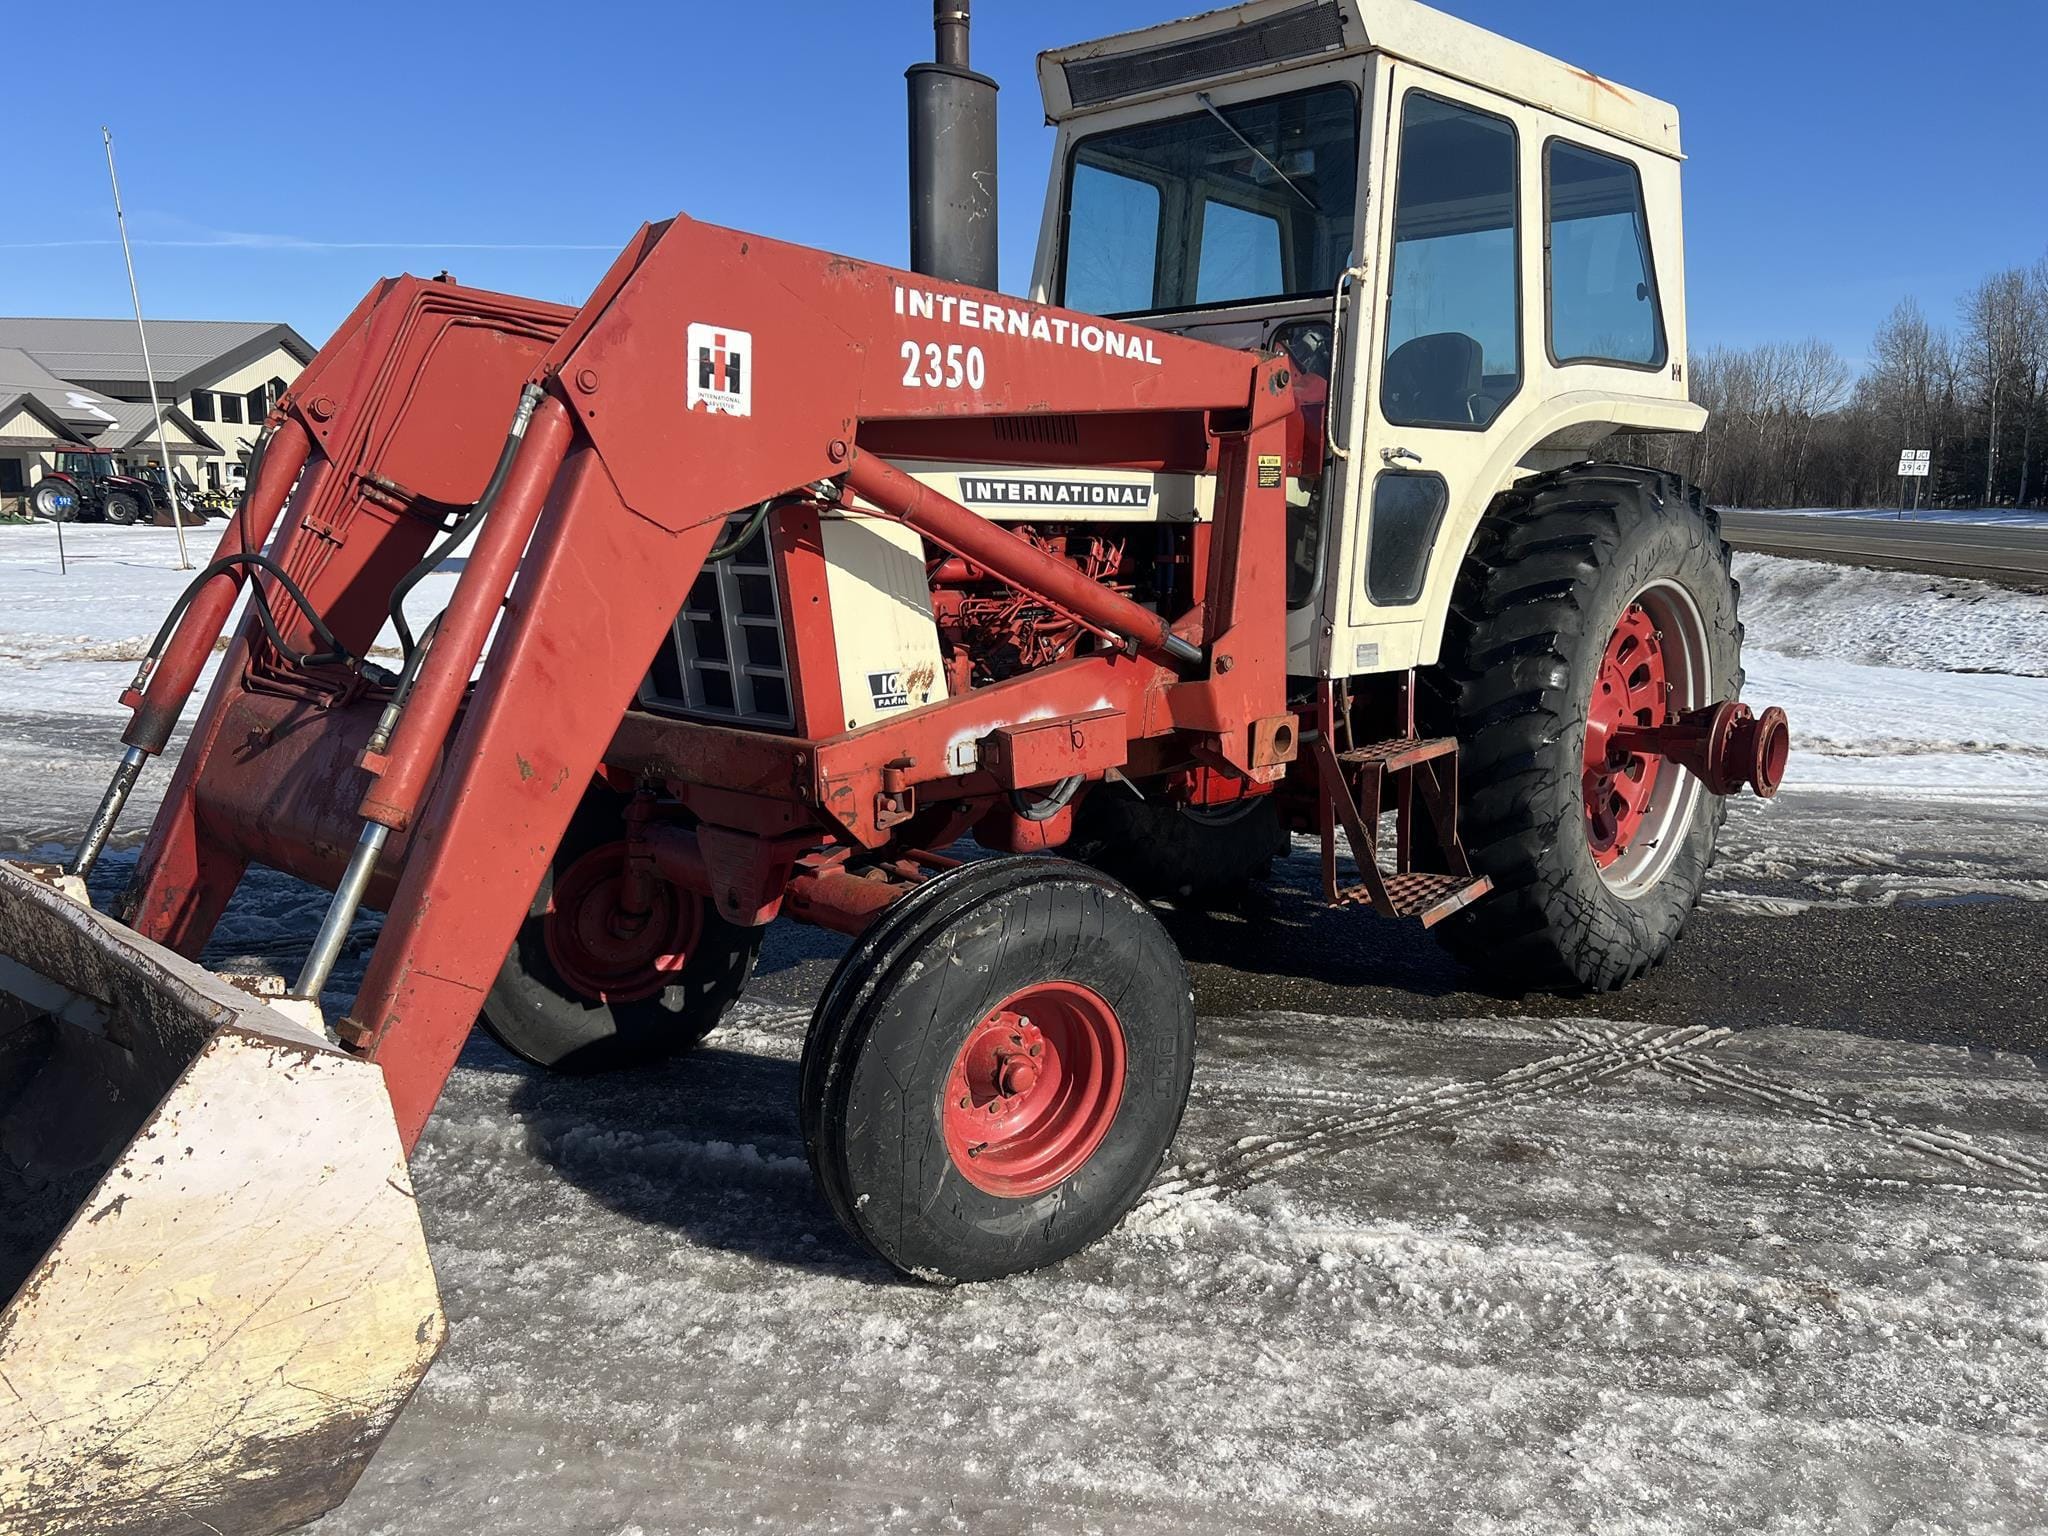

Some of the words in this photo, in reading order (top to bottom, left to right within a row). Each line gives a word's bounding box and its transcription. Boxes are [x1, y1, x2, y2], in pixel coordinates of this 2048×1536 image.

[894, 286, 1162, 364] INTERNATIONAL
[900, 340, 985, 390] 2350
[698, 392, 741, 404] INTERNATIONAL
[966, 481, 1147, 504] INTERNATIONAL
